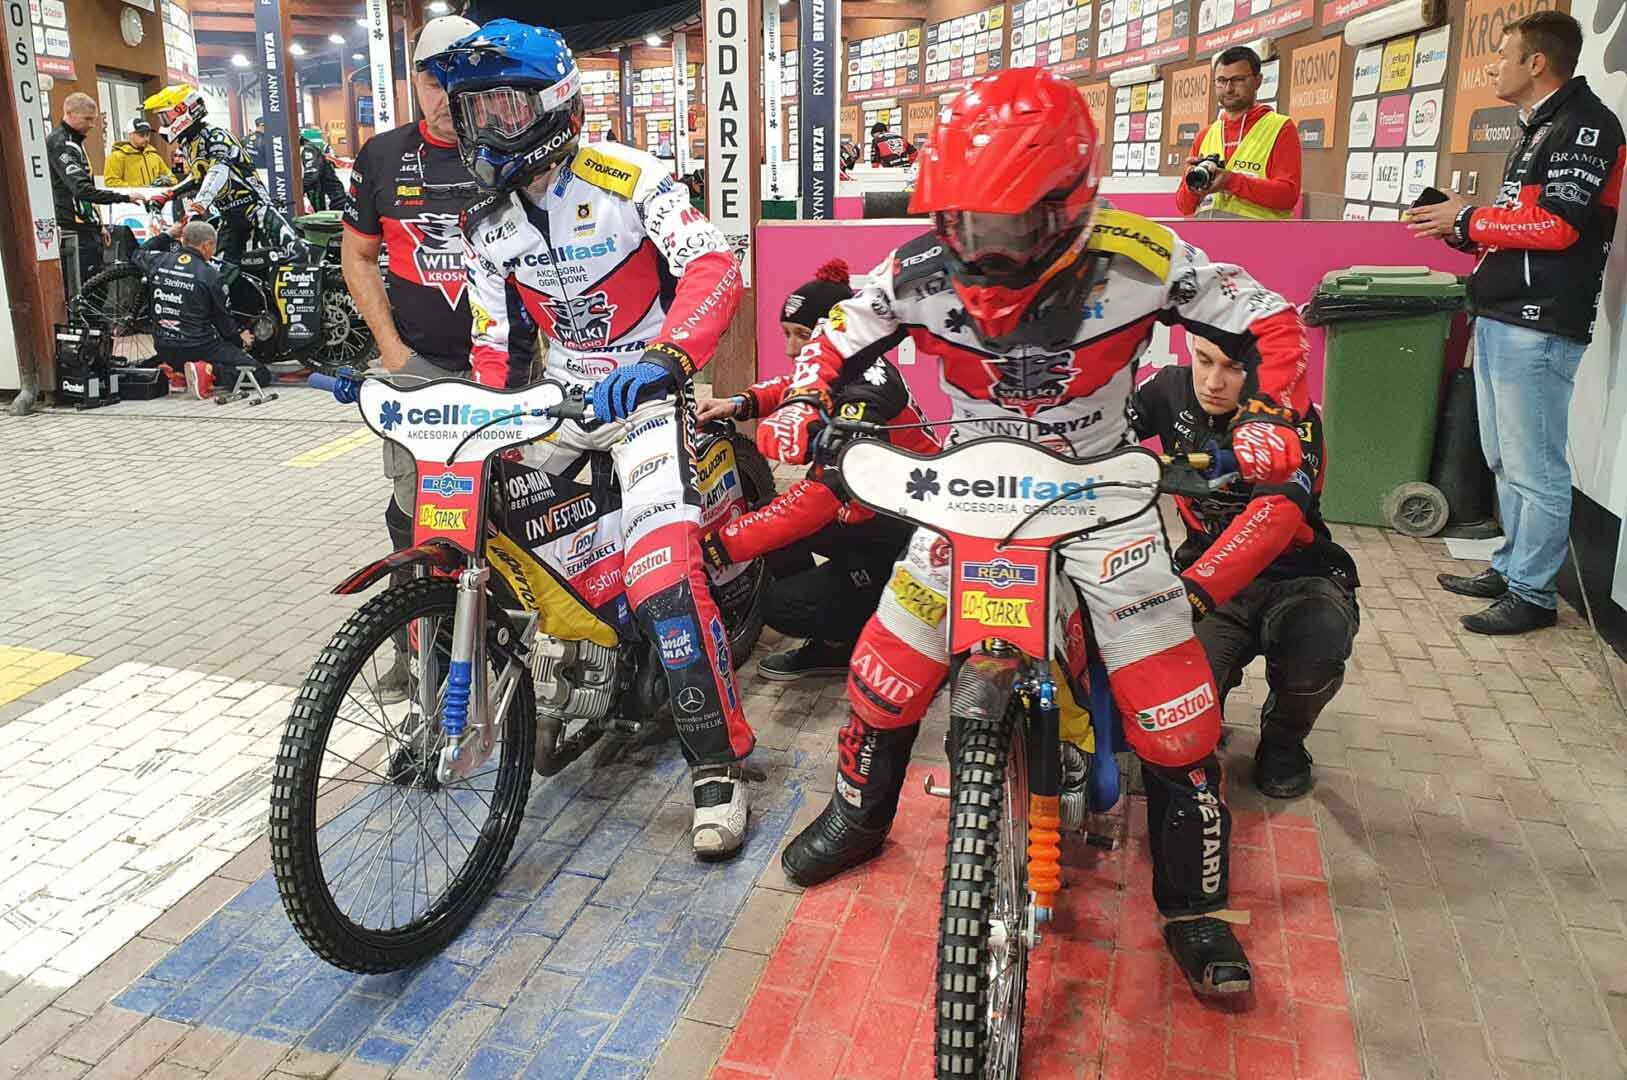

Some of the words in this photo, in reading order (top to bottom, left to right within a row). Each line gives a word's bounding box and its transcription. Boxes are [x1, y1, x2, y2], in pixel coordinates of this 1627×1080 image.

[264, 32, 277, 70] BRYZA
[813, 48, 825, 96] RYNNY
[1293, 51, 1337, 86] KROSNO
[269, 73, 280, 112] RYNNY
[1173, 73, 1208, 99] KROSNO
[271, 136, 285, 172] BRYZA
[524, 128, 573, 165] TEXOM
[583, 158, 632, 182] STOCENT
[1233, 159, 1261, 172] FOTO
[1550, 151, 1609, 170] BRAMEX
[277, 176, 288, 214] RNNY
[467, 194, 497, 214] TEXO
[524, 236, 617, 267] cellfast
[901, 246, 943, 267] TEXO
[428, 271, 467, 281] KROSN
[538, 274, 589, 287] OGRDOWE
[560, 326, 604, 341] WILKI
[406, 401, 524, 426] cellfast
[407, 430, 458, 440] AKCESORIA
[505, 470, 552, 499] OB-MAN
[947, 475, 1098, 500] cellfast
[510, 497, 530, 511] BERT
[947, 502, 1018, 514] AKCESORIA
[1212, 500, 1276, 565] INWENTECH
[631, 549, 668, 578] Castrol
[663, 645, 694, 660] MAK
[850, 653, 914, 704] AMD
[1156, 687, 1212, 727] Castrol
